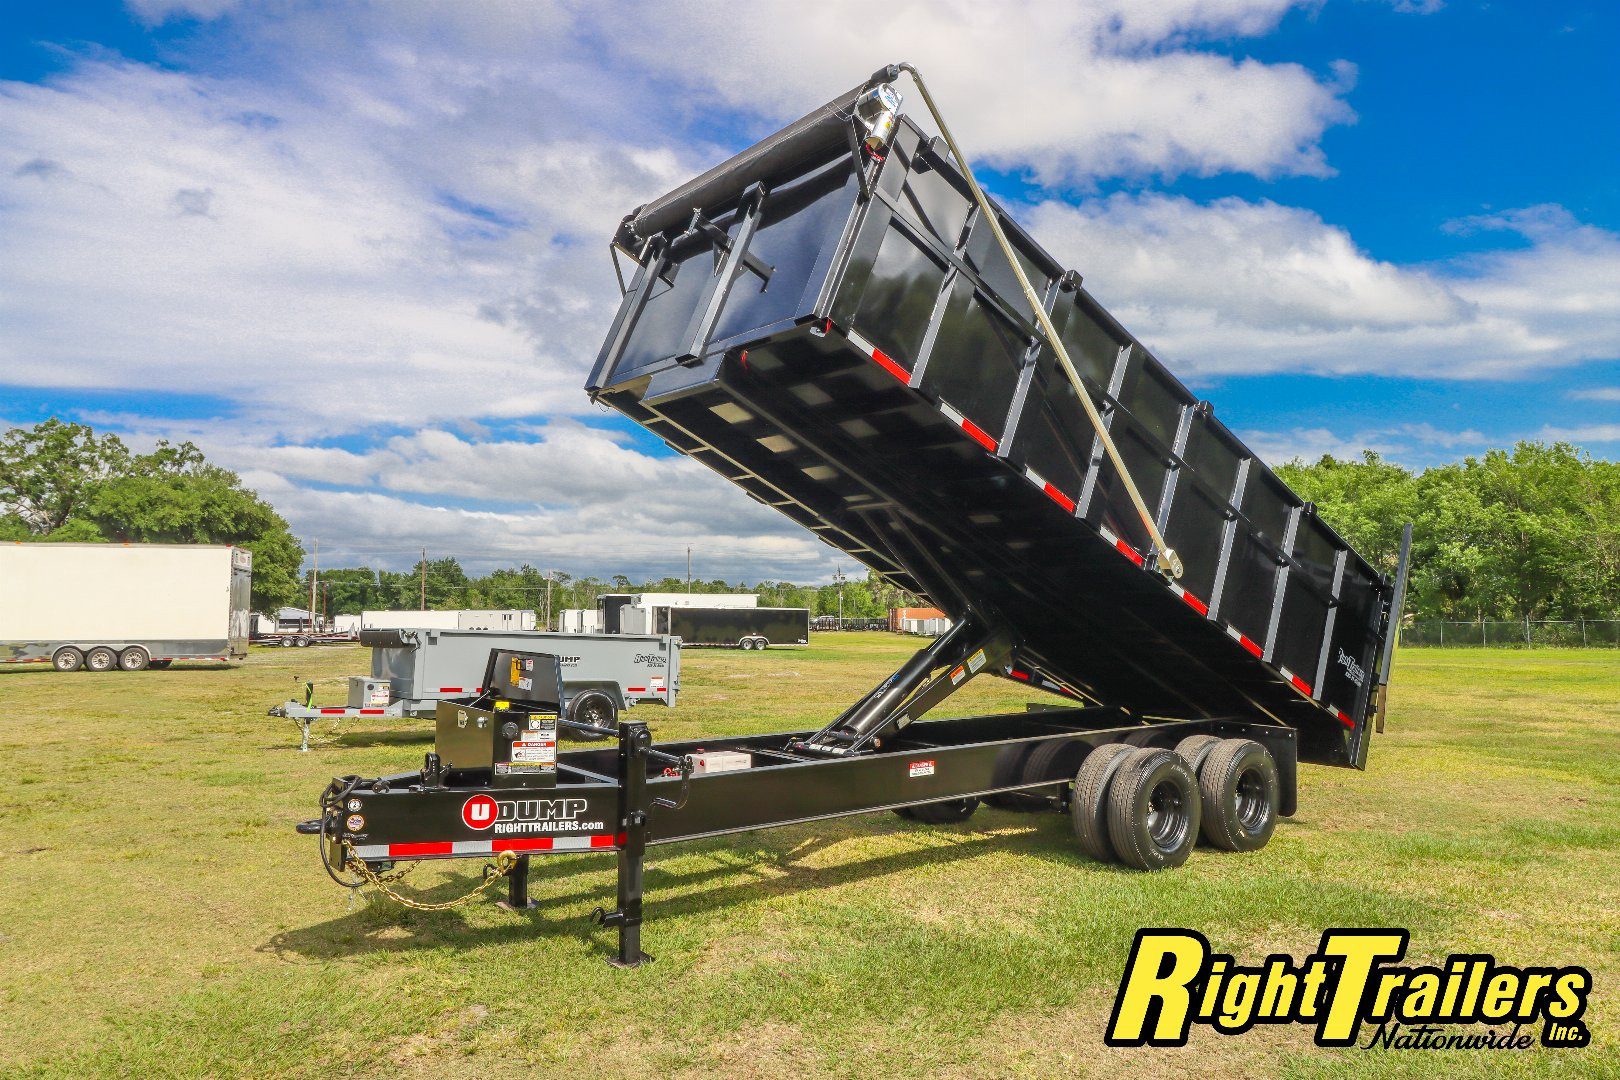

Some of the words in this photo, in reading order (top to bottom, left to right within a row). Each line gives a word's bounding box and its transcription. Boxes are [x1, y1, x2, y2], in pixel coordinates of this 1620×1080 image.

[559, 655, 580, 664] UMP
[496, 798, 588, 822] DUMP
[494, 820, 604, 834] RIGHTTRAILERS.com
